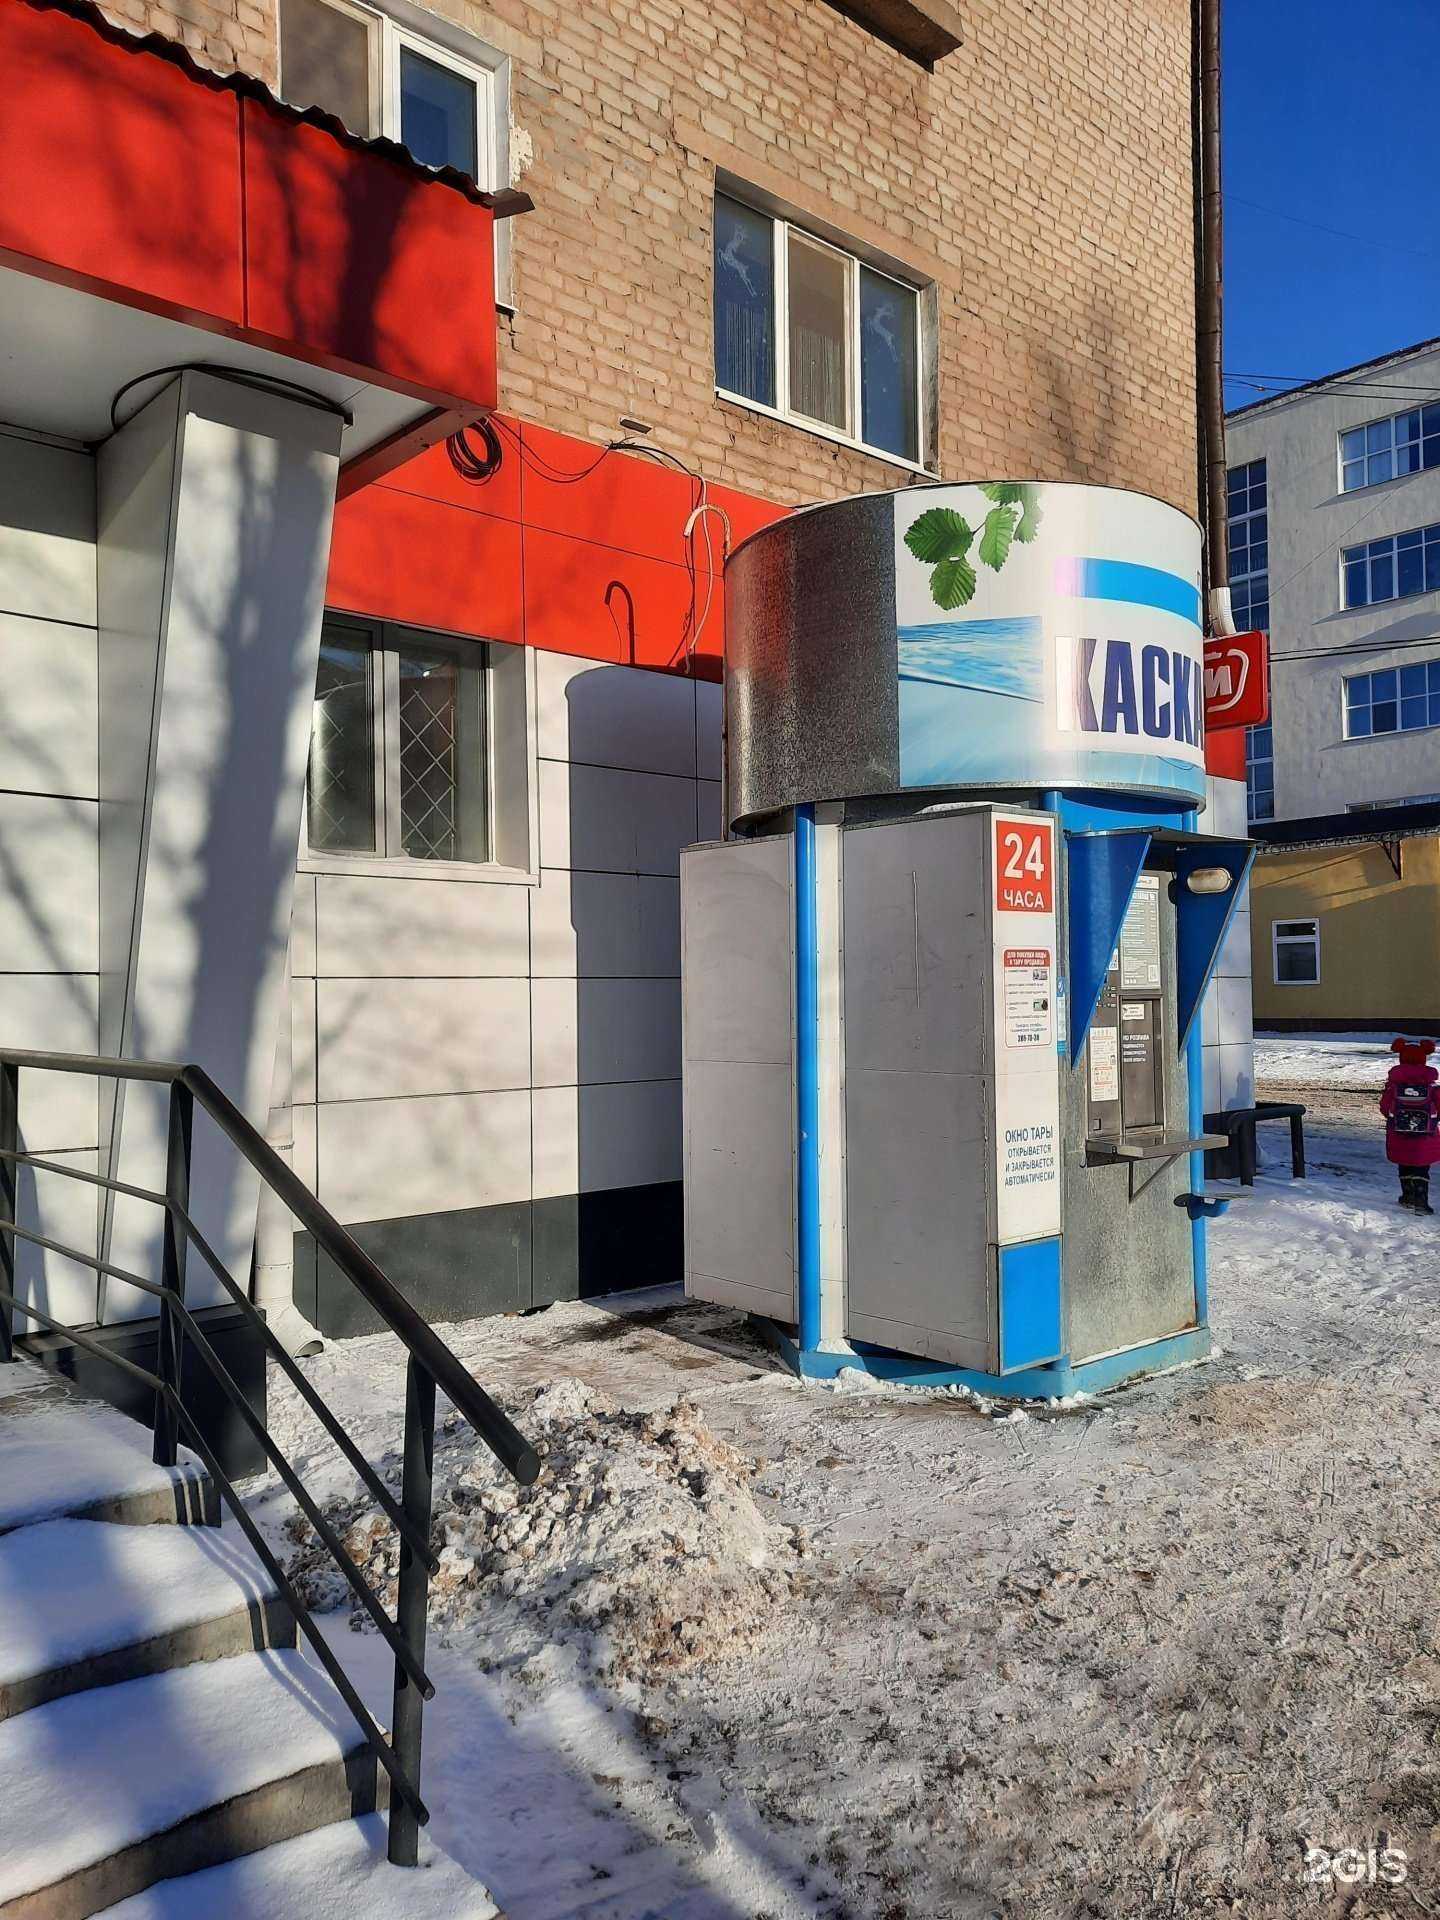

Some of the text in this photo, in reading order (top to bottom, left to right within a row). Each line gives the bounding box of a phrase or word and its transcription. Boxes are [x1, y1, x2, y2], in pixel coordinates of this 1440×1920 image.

[1004, 832, 1045, 880] 24
[1003, 888, 1045, 909] ЧАСА
[1005, 1125, 1053, 1143] ОКНО ТАРЫ
[1008, 1144, 1052, 1158] ОТКРЫВАЕТСЯ
[1005, 1157, 1054, 1173] И ЗАКРЫВАЕТСЯ
[1005, 1171, 1055, 1187] АВТОМАТИЧЕСКИ
